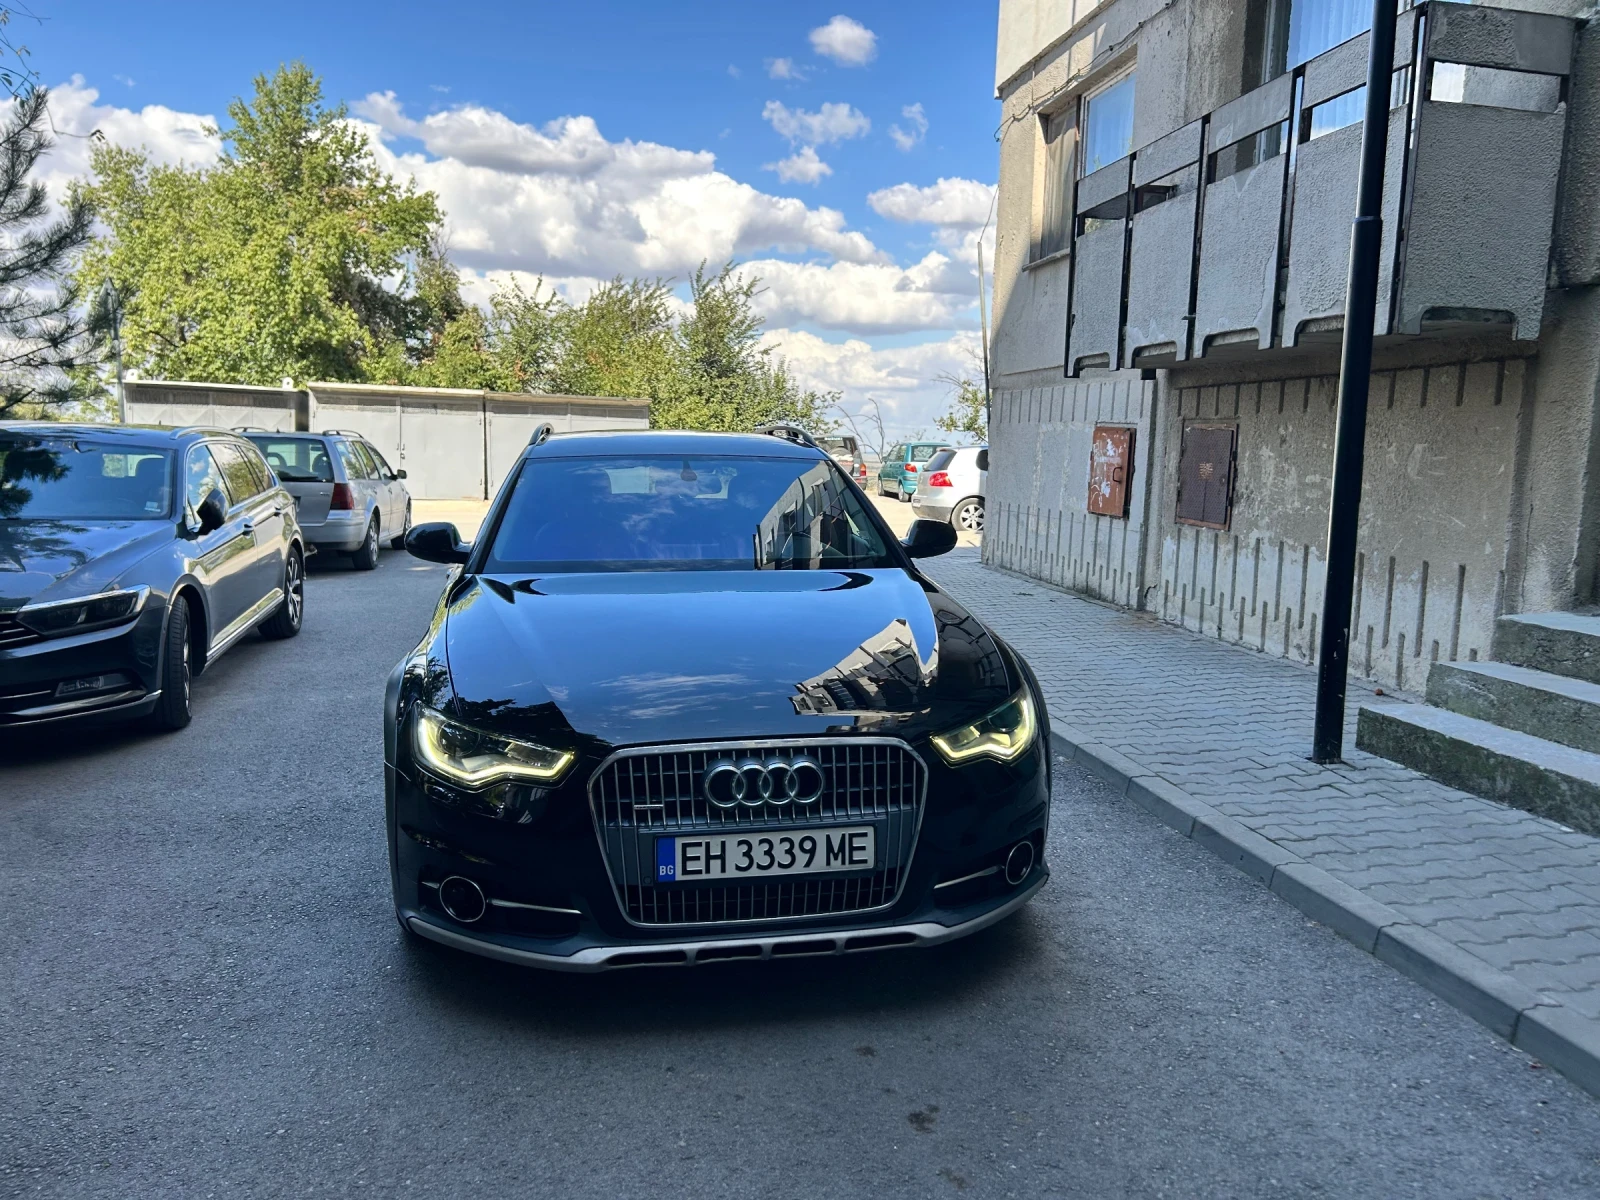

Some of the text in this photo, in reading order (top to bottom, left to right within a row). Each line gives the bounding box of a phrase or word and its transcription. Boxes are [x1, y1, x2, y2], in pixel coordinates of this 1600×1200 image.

[681, 832, 869, 876] EH 3339 ME
[659, 865, 674, 876] BG
